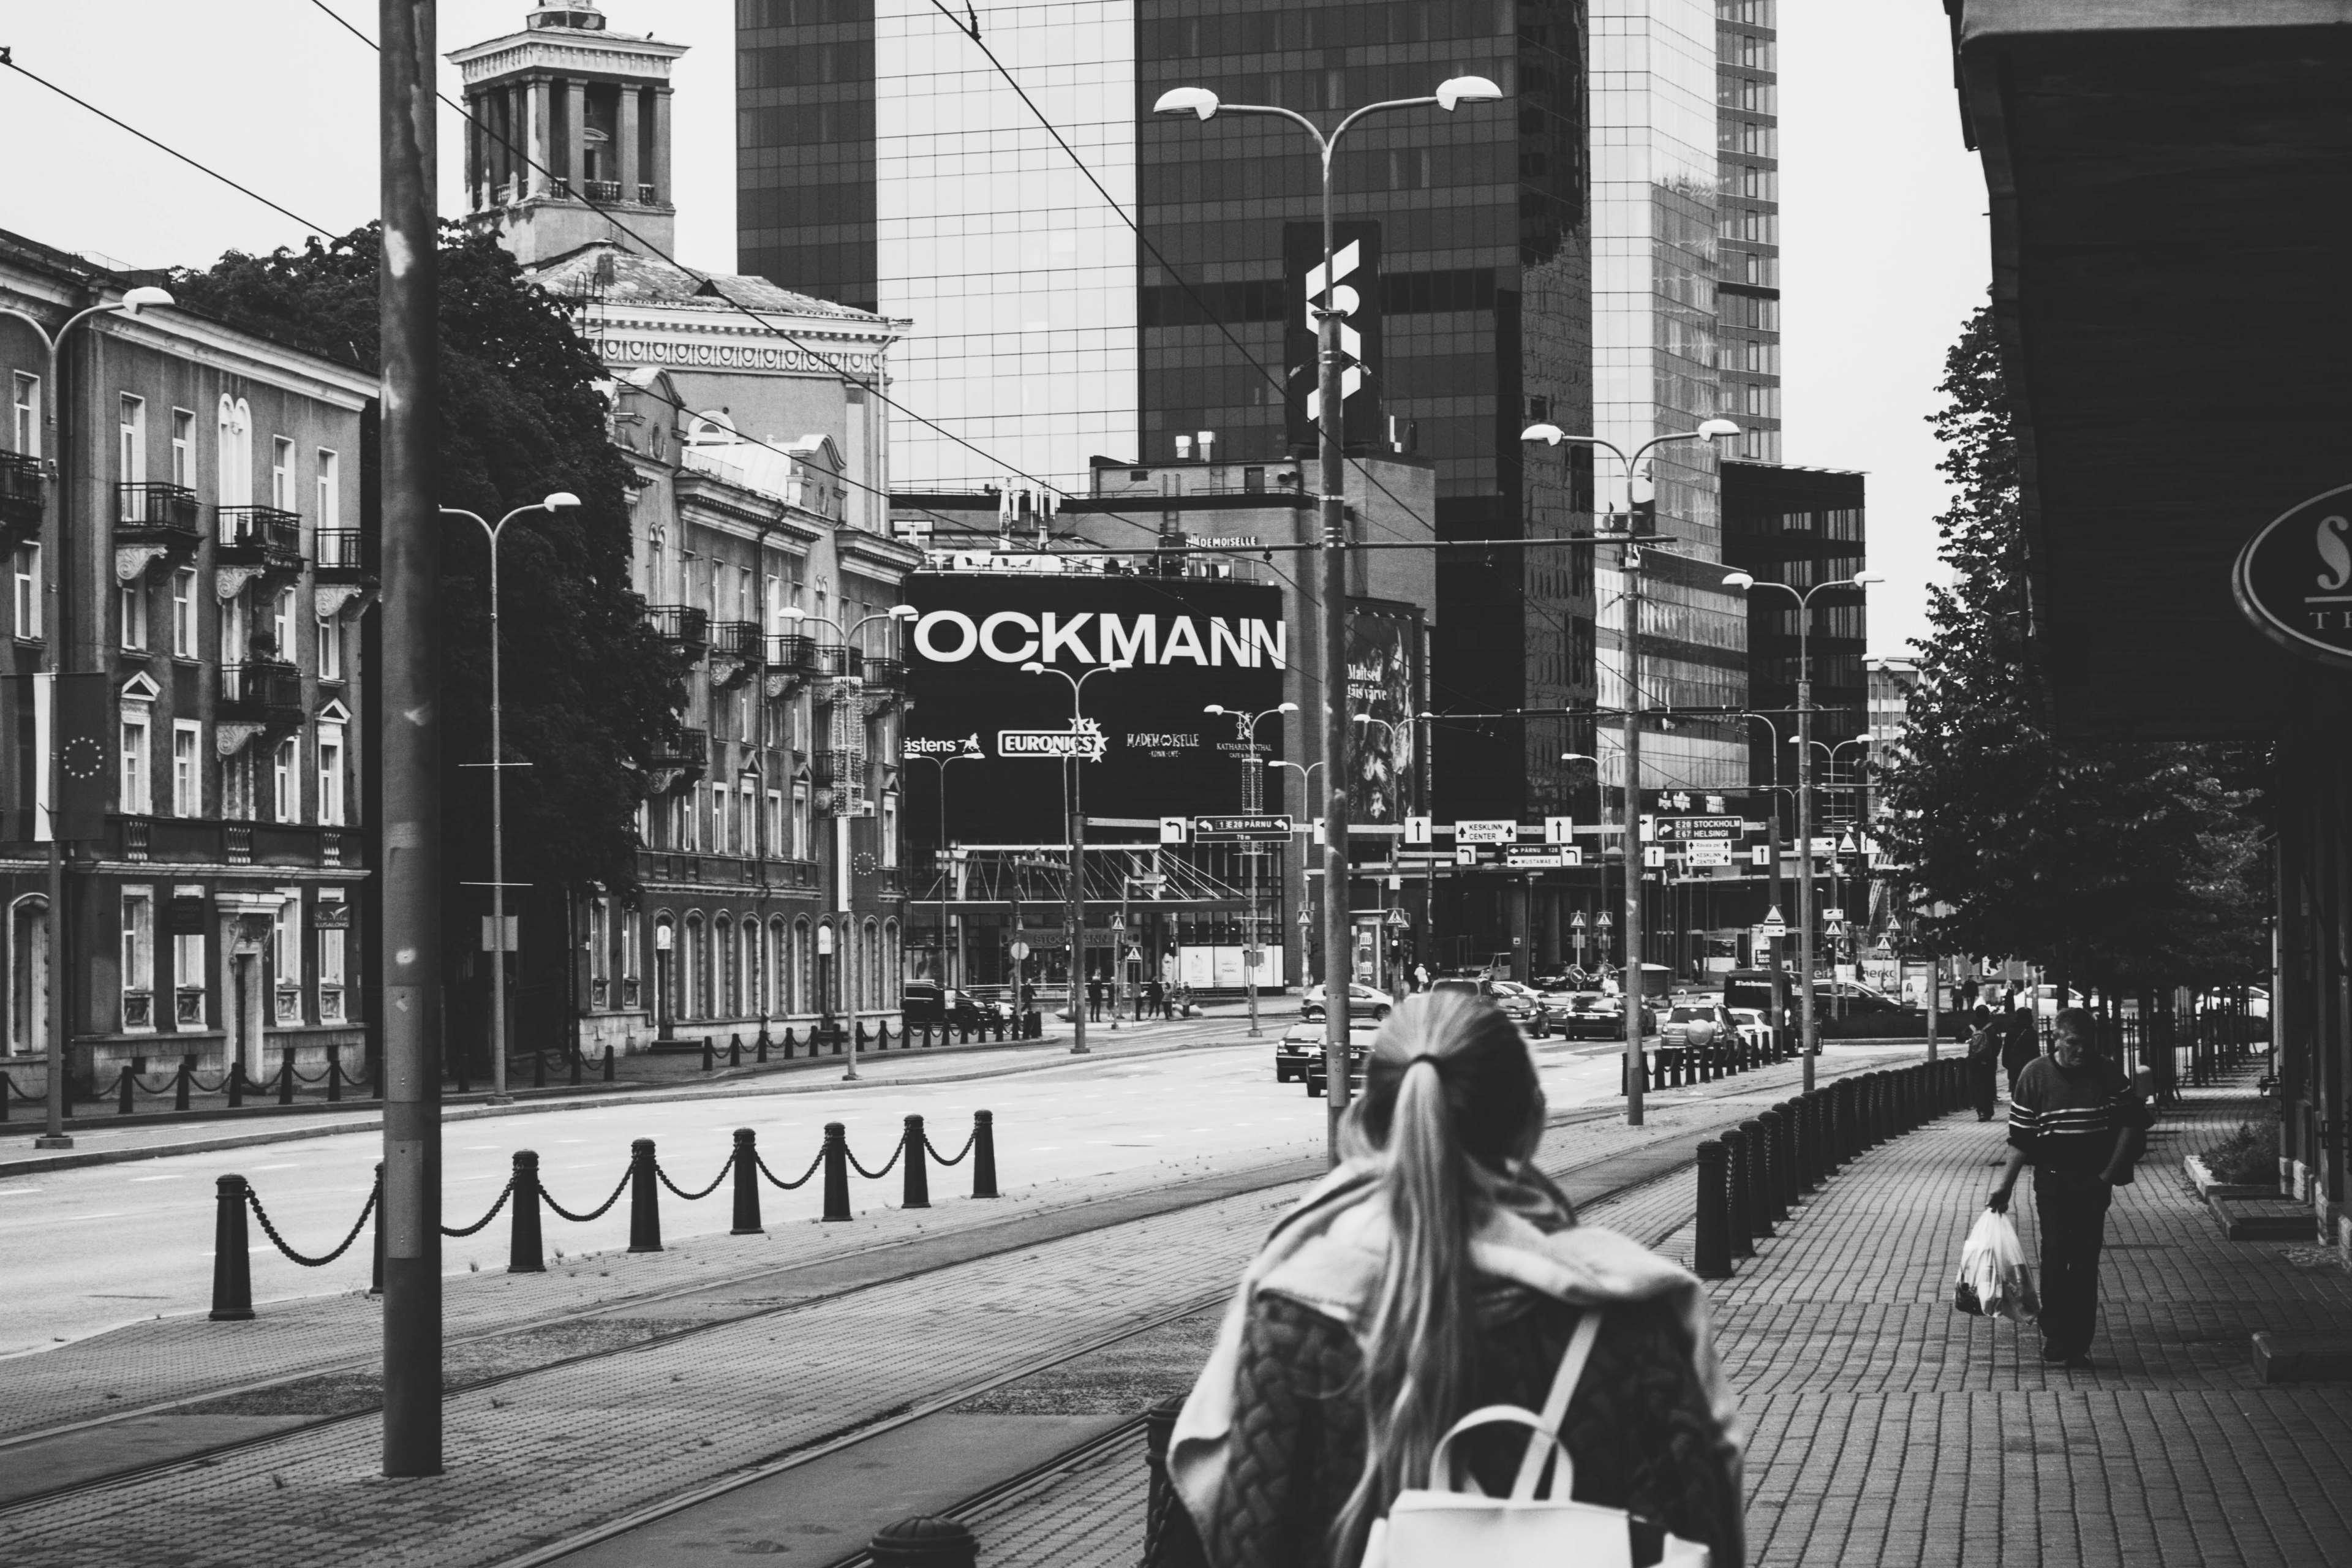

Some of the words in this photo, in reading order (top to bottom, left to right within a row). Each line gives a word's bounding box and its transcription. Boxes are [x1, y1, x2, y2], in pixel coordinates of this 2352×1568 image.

[904, 610, 1286, 669] OCKMANN
[1005, 736, 1093, 752] EURONICS
[1244, 820, 1272, 828] PÄRNU
